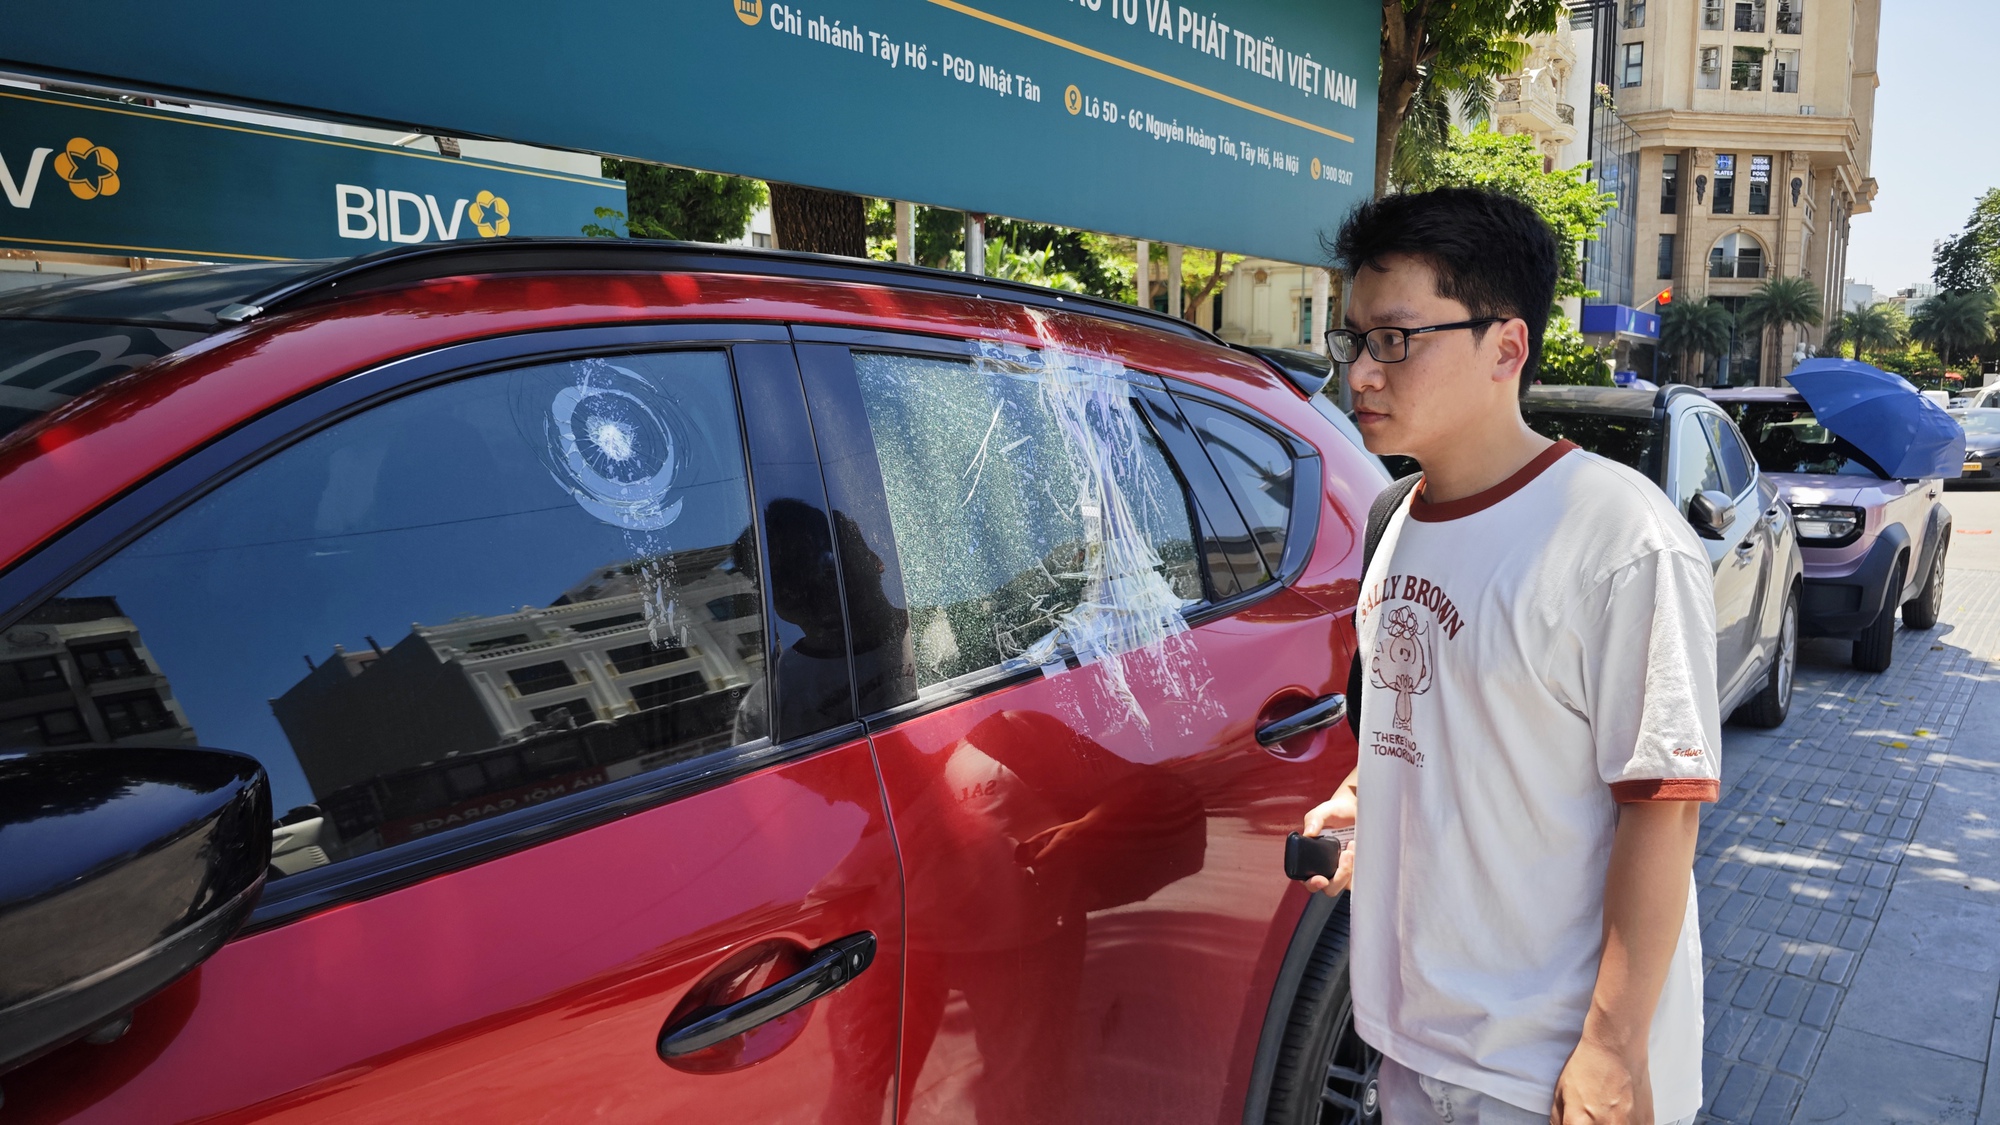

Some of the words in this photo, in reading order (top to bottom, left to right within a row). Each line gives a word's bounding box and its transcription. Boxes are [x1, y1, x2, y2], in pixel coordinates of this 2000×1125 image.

[769, 3, 802, 36] Chi
[808, 16, 864, 53] nhánh
[868, 31, 900, 68] Tây
[904, 42, 927, 71] Hồ
[943, 53, 975, 83] PGD
[978, 64, 1013, 97] Nhật
[1015, 74, 1041, 102] Tân
[1178, 6, 1230, 60] PHÁT
[1233, 29, 1284, 82] TRIỂN
[1287, 51, 1322, 97] VIỆT
[1324, 67, 1357, 109] NAM
[1085, 96, 1100, 119] Lô
[1102, 100, 1118, 123] 5D
[1128, 109, 1144, 131] 6C
[1145, 113, 1184, 143] Nguyễn
[1186, 125, 1217, 155] Hoàng
[1218, 135, 1239, 161] Tôn,
[1240, 141, 1257, 166] Tây
[1273, 151, 1284, 170] Hà
[1285, 154, 1299, 176] Nội
[1322, 164, 1337, 183] 1900
[1338, 169, 1353, 186] 9247
[336, 183, 469, 243] BIDV
[1362, 575, 1401, 624] SALLY
[1402, 575, 1465, 641] BROWN
